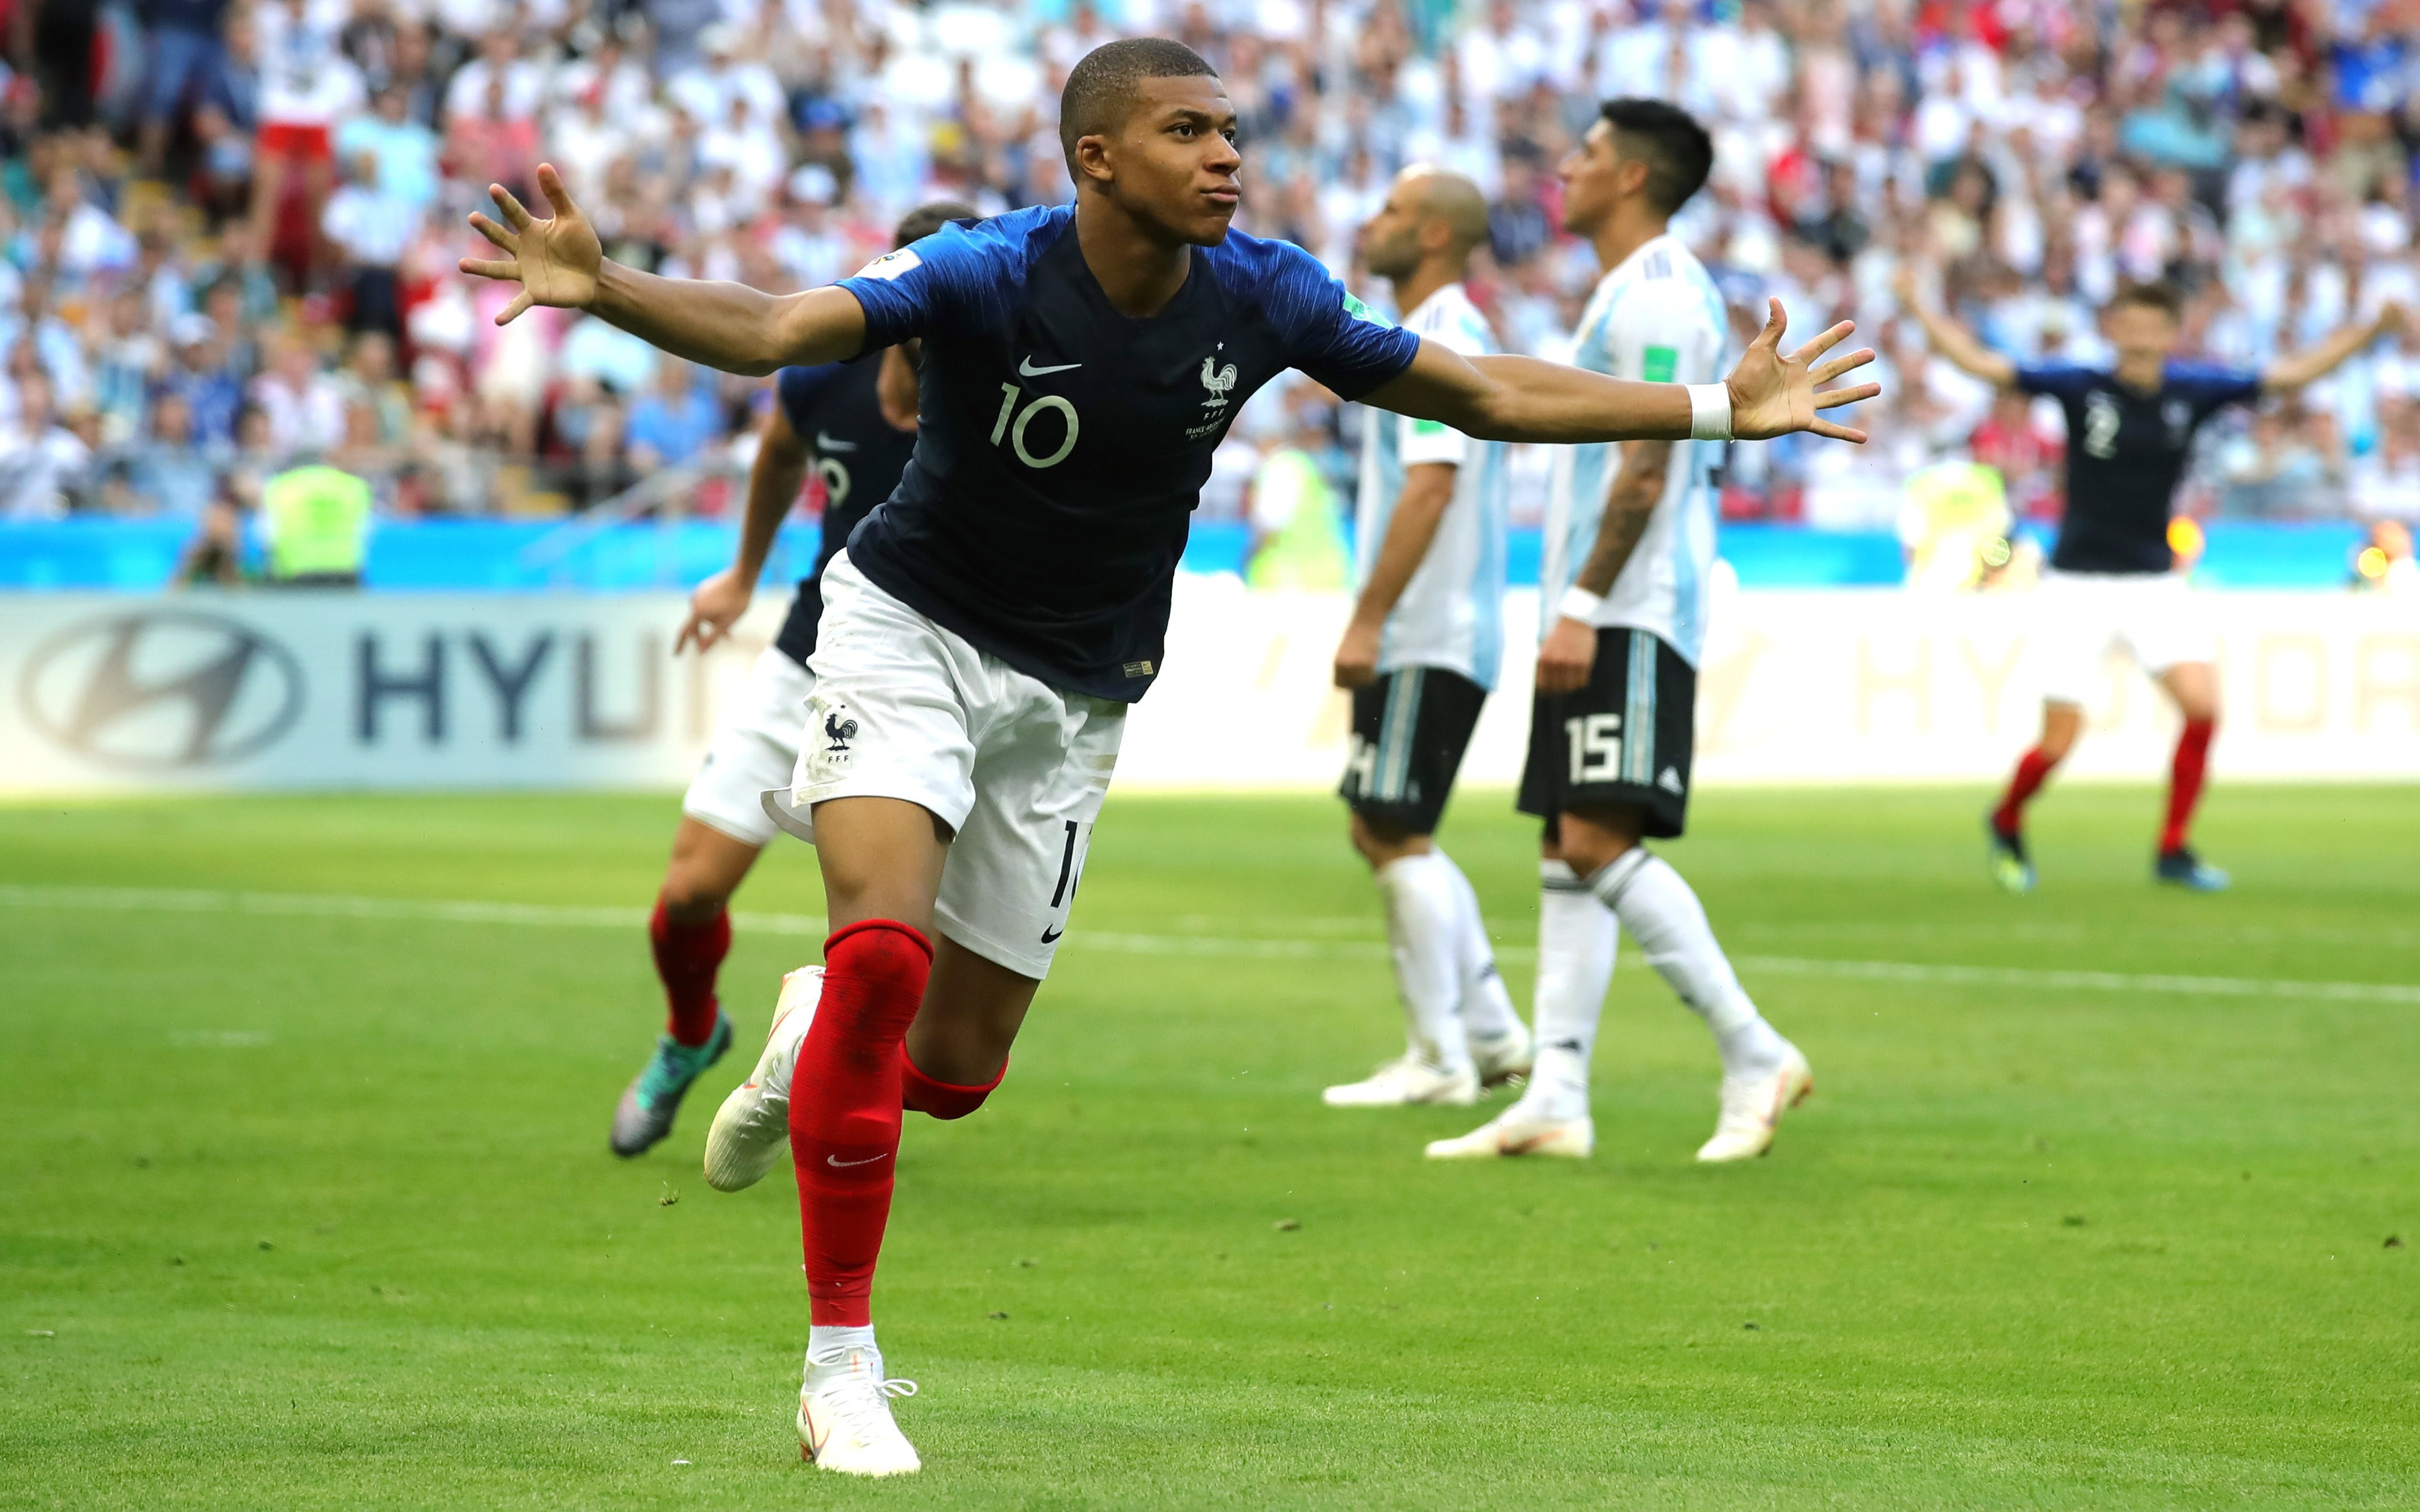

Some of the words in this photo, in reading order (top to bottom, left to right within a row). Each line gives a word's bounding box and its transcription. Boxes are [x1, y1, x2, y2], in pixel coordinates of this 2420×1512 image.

[990, 382, 1080, 469] 10
[1565, 713, 1623, 783] 15
[1050, 820, 1093, 908] 1
